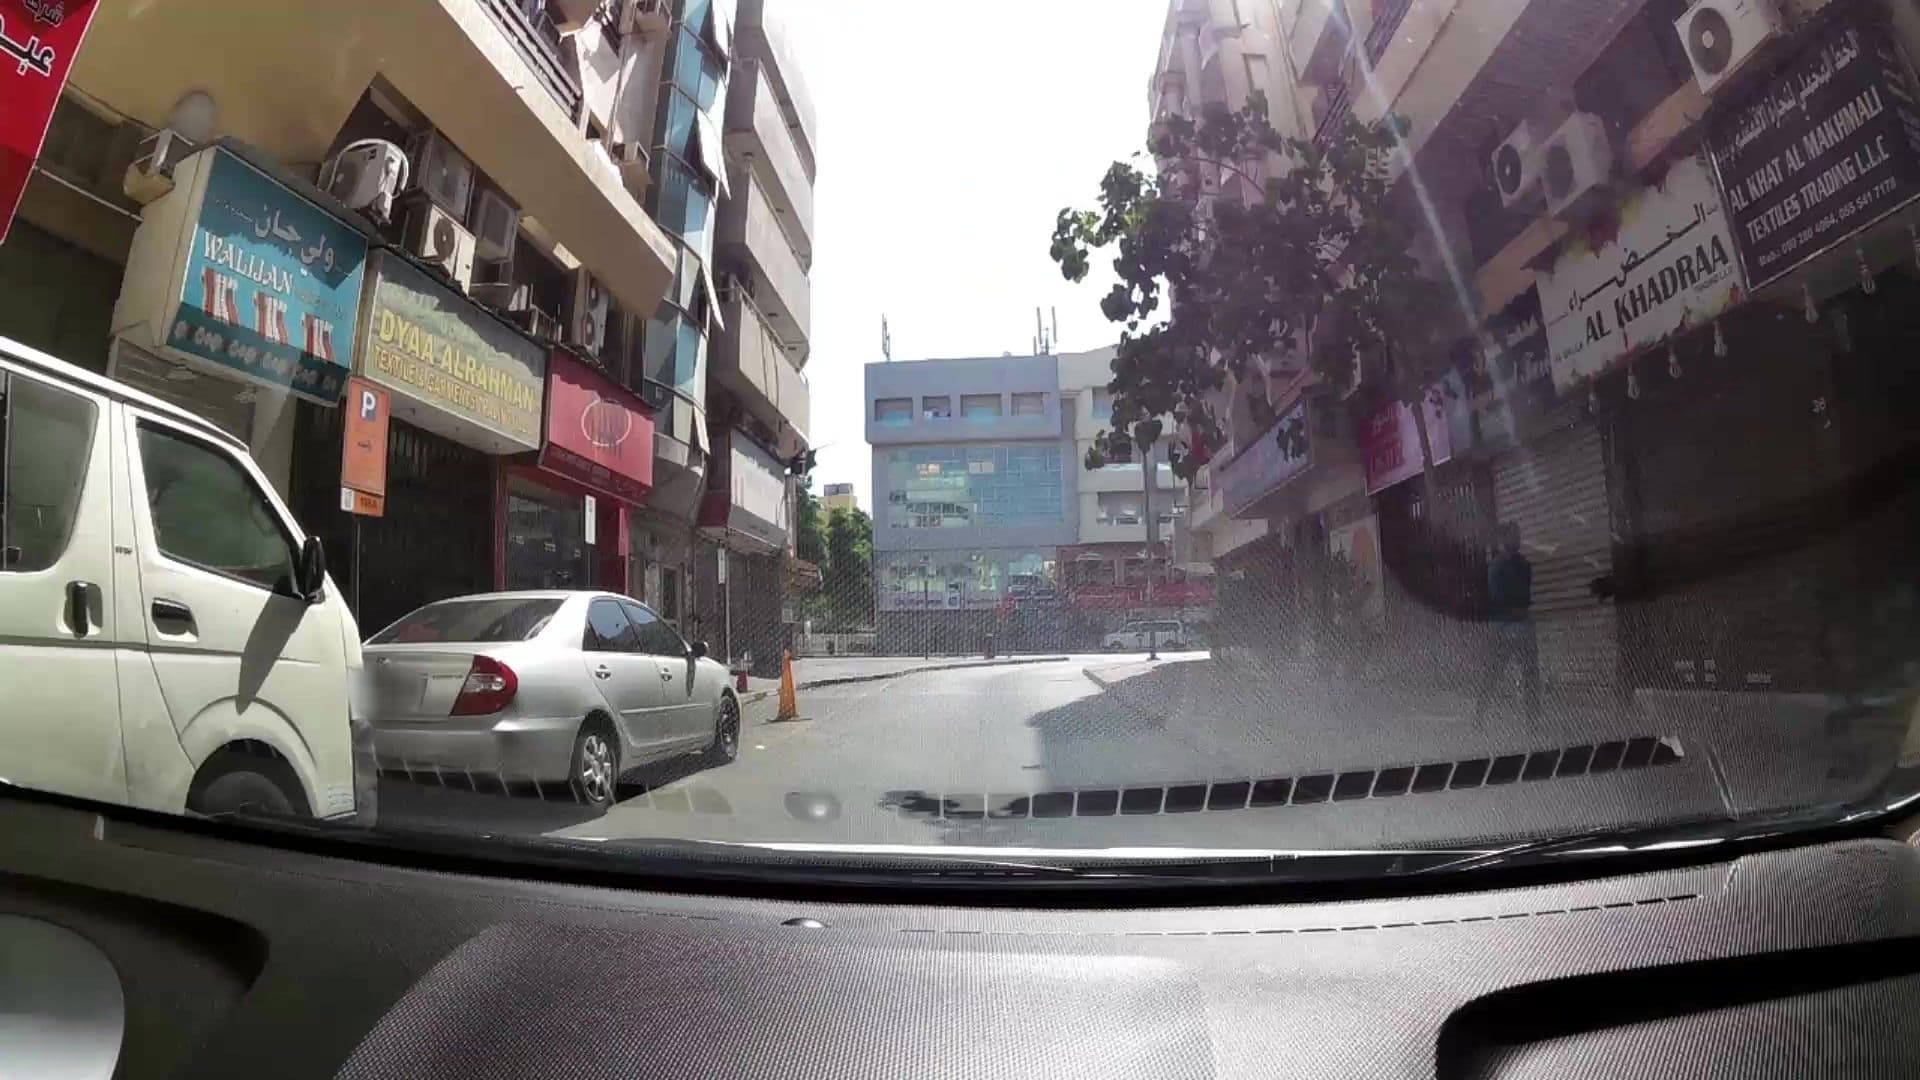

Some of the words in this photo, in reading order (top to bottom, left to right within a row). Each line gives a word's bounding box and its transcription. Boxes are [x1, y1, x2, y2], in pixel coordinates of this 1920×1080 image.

[1729, 185, 1750, 214] AL
[1746, 157, 1784, 201] KHAT
[1785, 144, 1806, 176] AL
[1802, 85, 1883, 160] MAKHMALI
[255, 203, 302, 257] جان
[1745, 193, 1801, 244] TEXTILES
[1800, 156, 1857, 210] TRADING
[203, 231, 294, 294] WALIJAN
[300, 233, 336, 277] ولي
[1586, 310, 1612, 345] AL
[1614, 234, 1729, 328] KHADRAA
[379, 308, 435, 365] DYAA
[440, 343, 535, 413] ALRAHMAN
[361, 391, 376, 418] P
